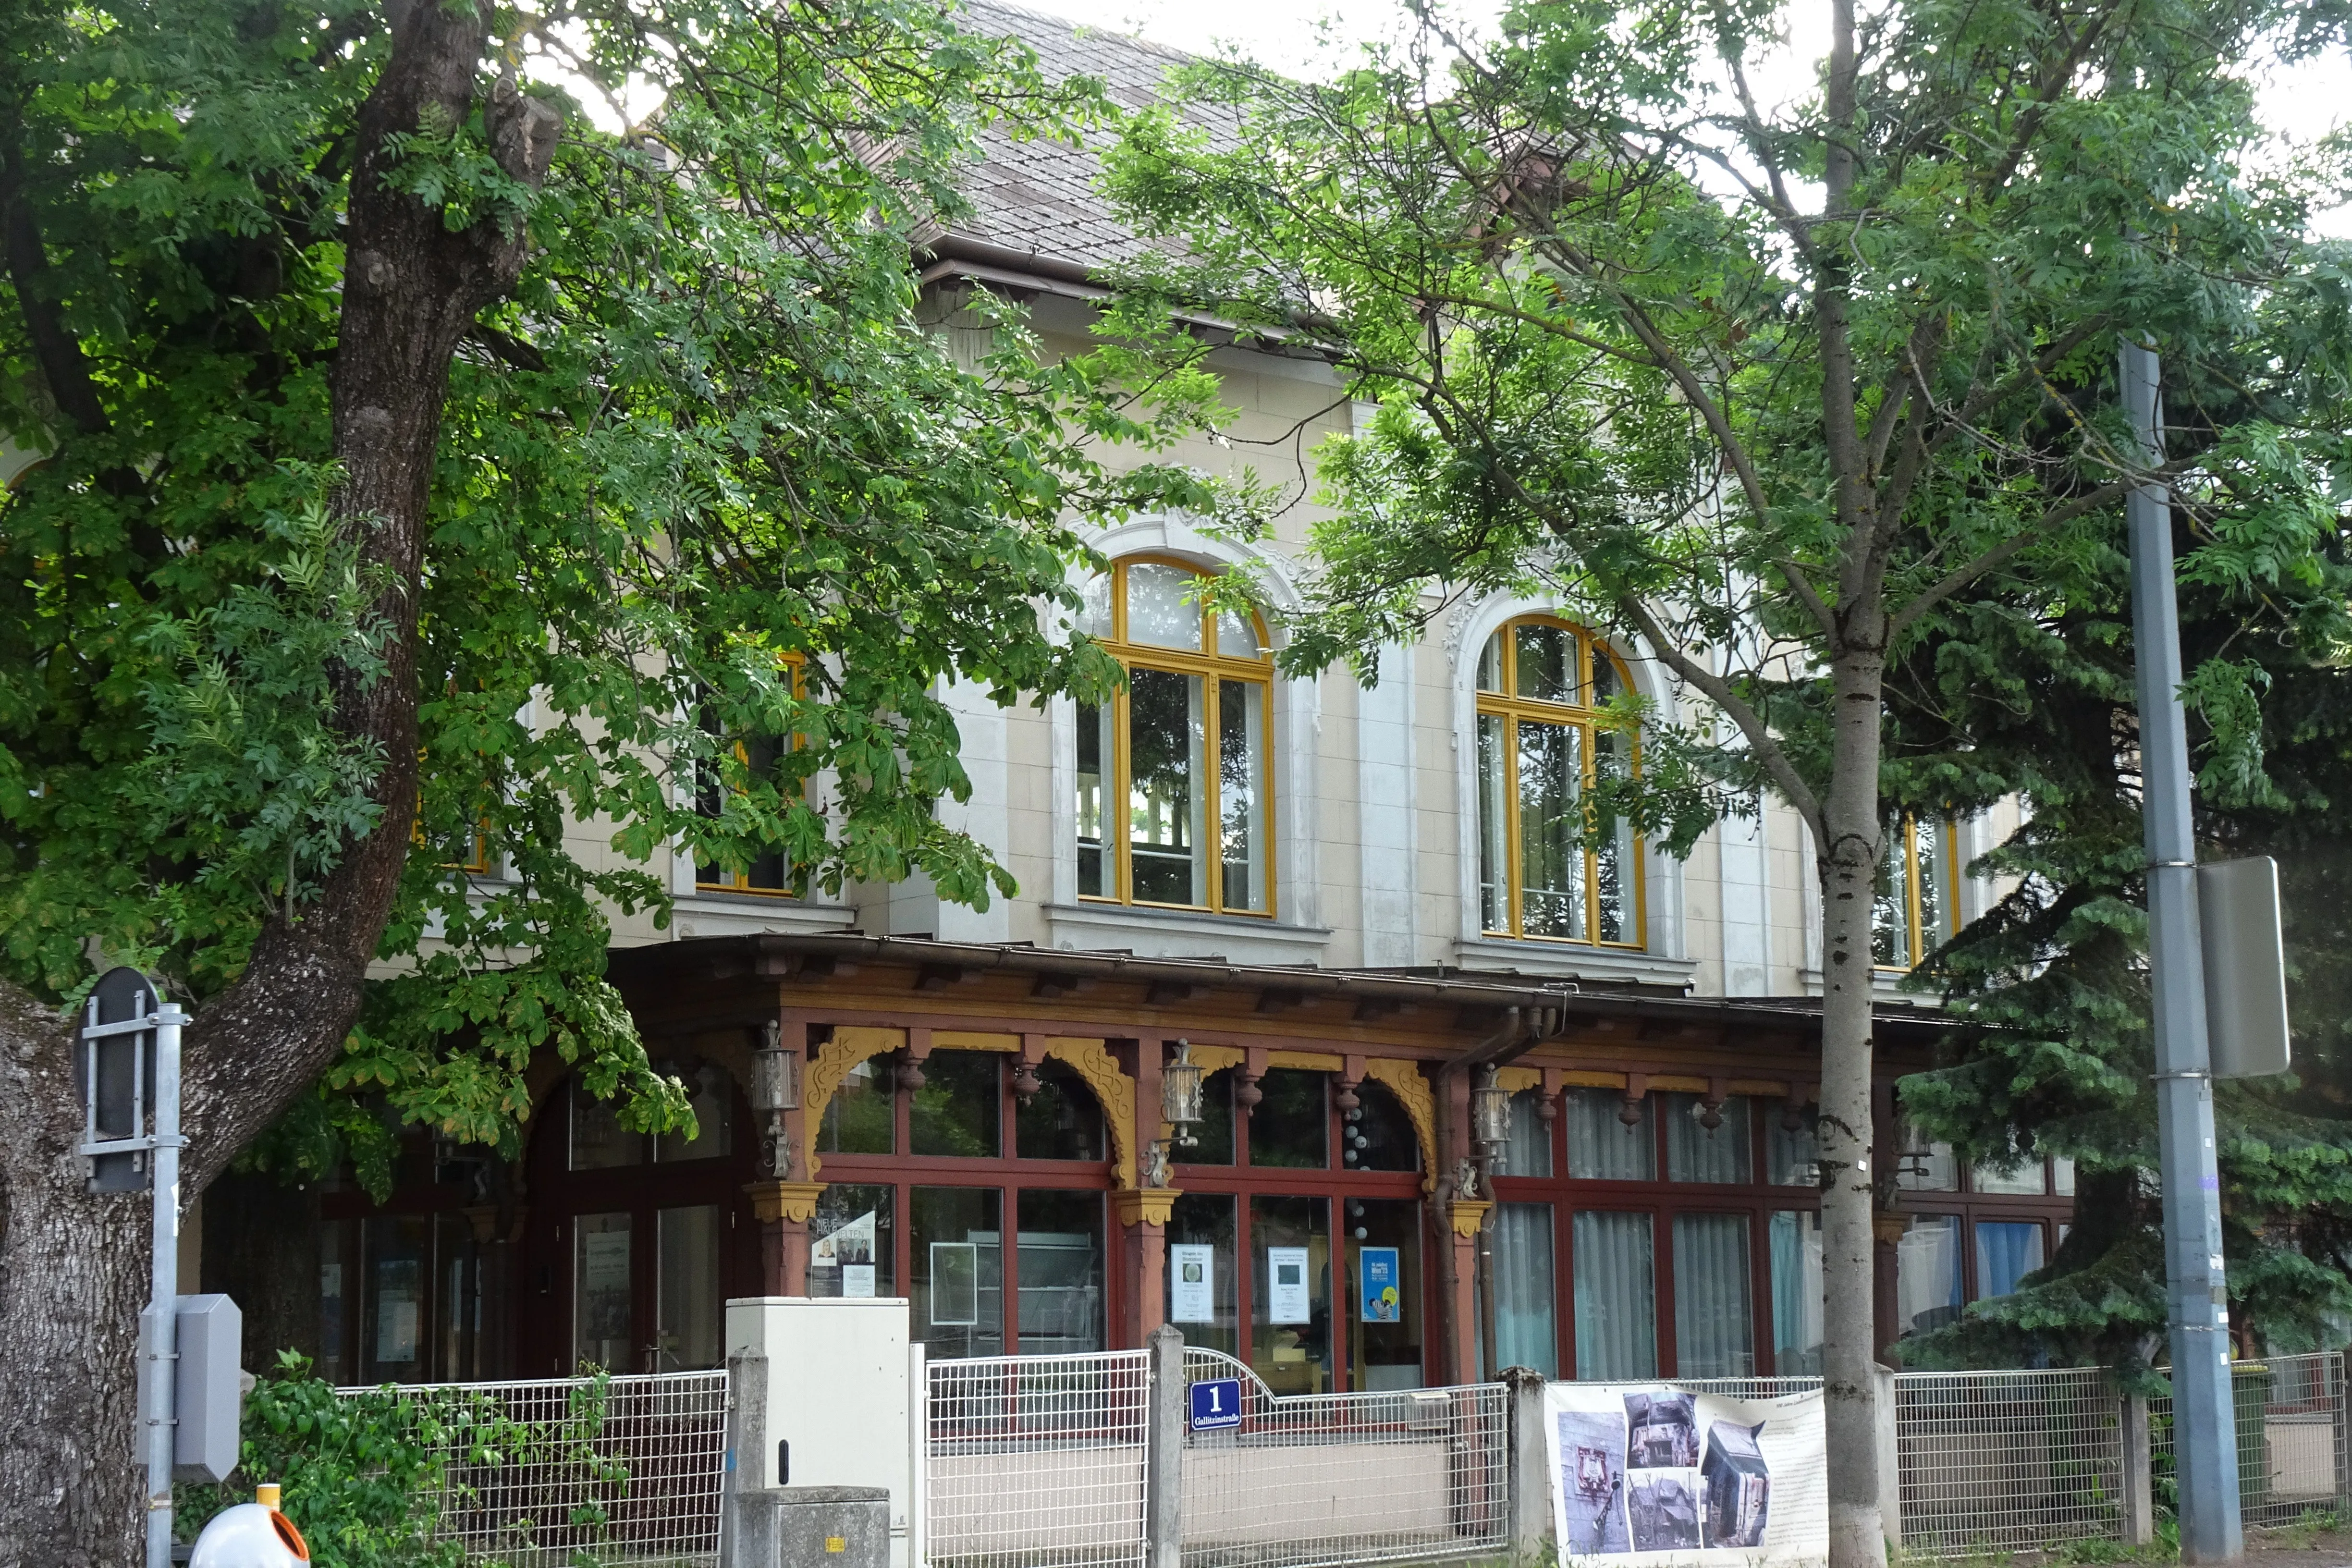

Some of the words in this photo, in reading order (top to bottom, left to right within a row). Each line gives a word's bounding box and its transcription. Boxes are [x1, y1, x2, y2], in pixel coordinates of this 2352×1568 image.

[817, 1218, 837, 1227] NEUE
[834, 1230, 865, 1239] WELTEN
[1210, 1385, 1222, 1412] 1
[1195, 1413, 1239, 1426] Gallitzinstraße
